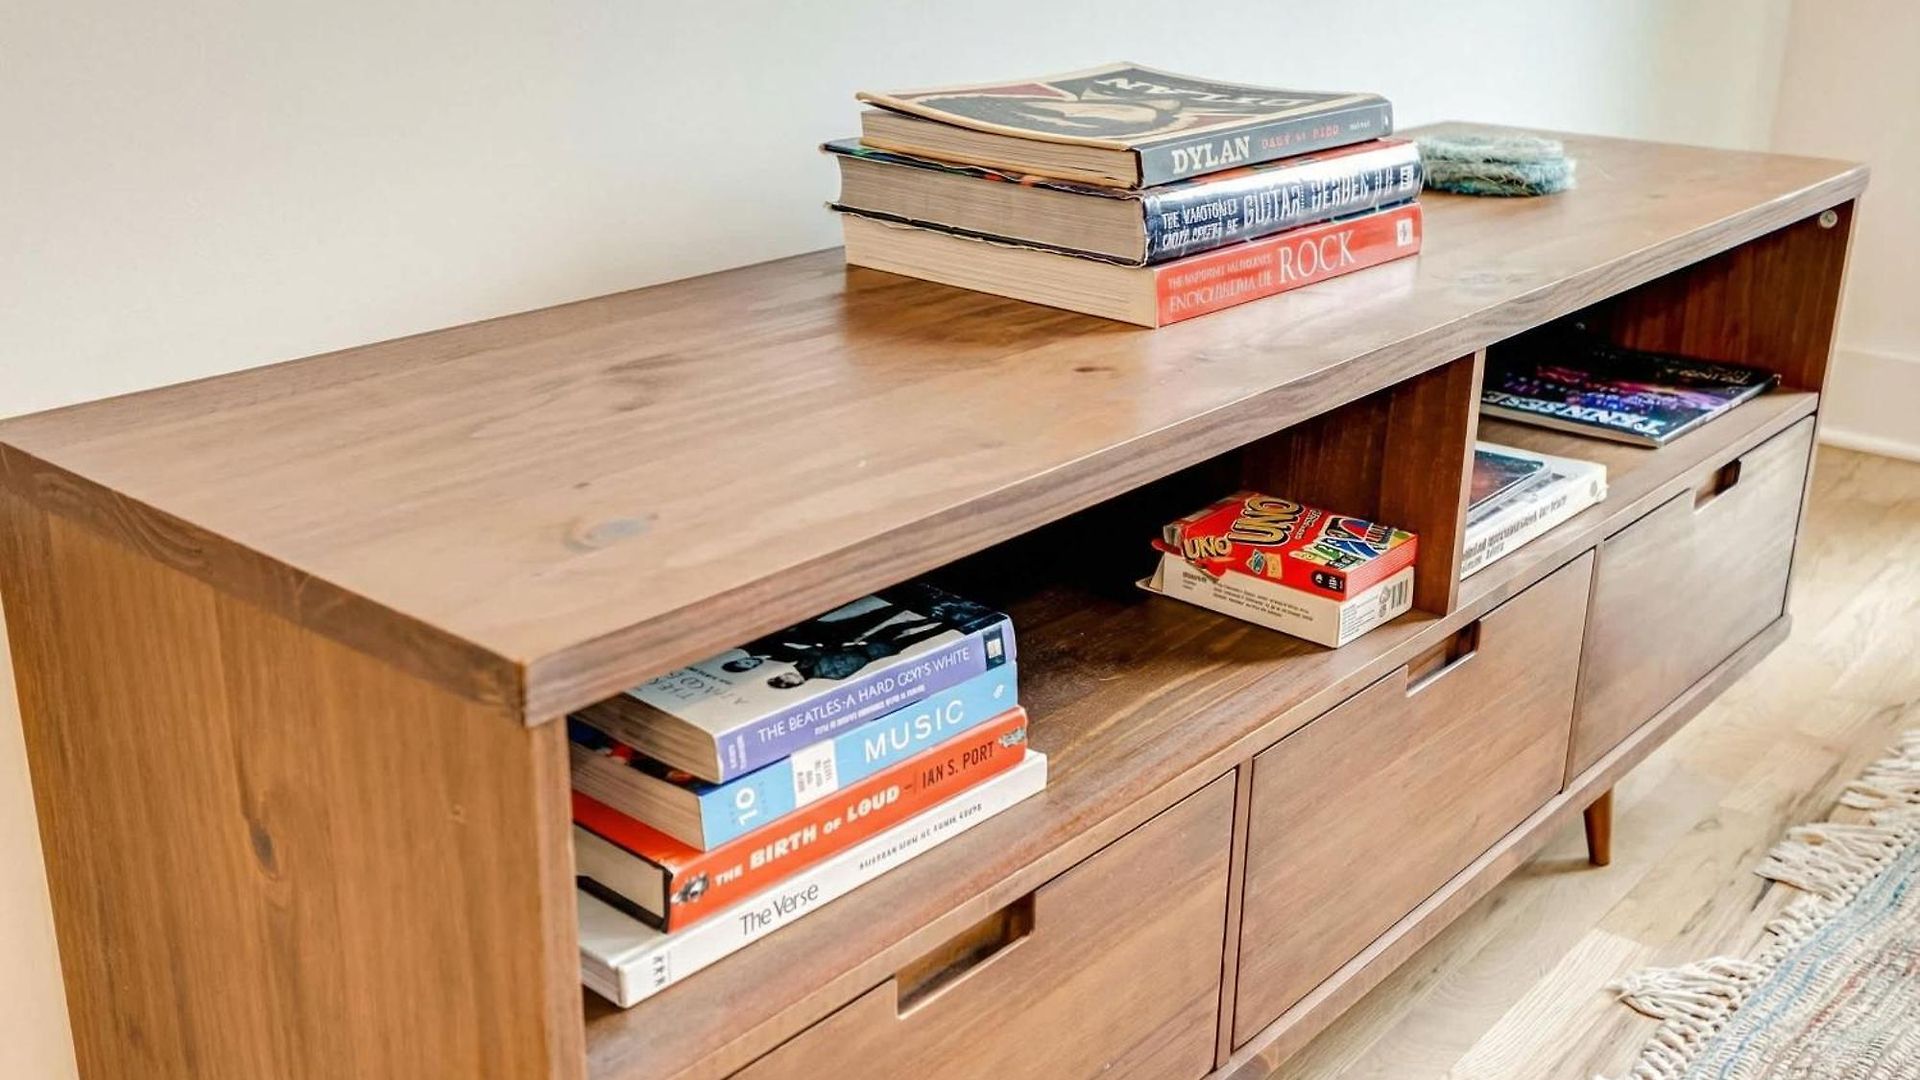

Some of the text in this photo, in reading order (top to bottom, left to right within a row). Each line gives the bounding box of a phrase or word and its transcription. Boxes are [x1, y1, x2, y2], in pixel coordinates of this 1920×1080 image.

[1171, 136, 1250, 175] DYLAN
[1278, 230, 1355, 284] ROCK
[1227, 496, 1304, 545] UNO
[1183, 536, 1233, 561] UNO
[758, 720, 786, 743] THE
[858, 679, 894, 702] HARD
[864, 700, 963, 763] MUSIC
[922, 741, 994, 789] IAN S. PORT
[715, 784, 900, 886] THE BIRTH OF LOUD
[738, 884, 819, 936] The Verse
